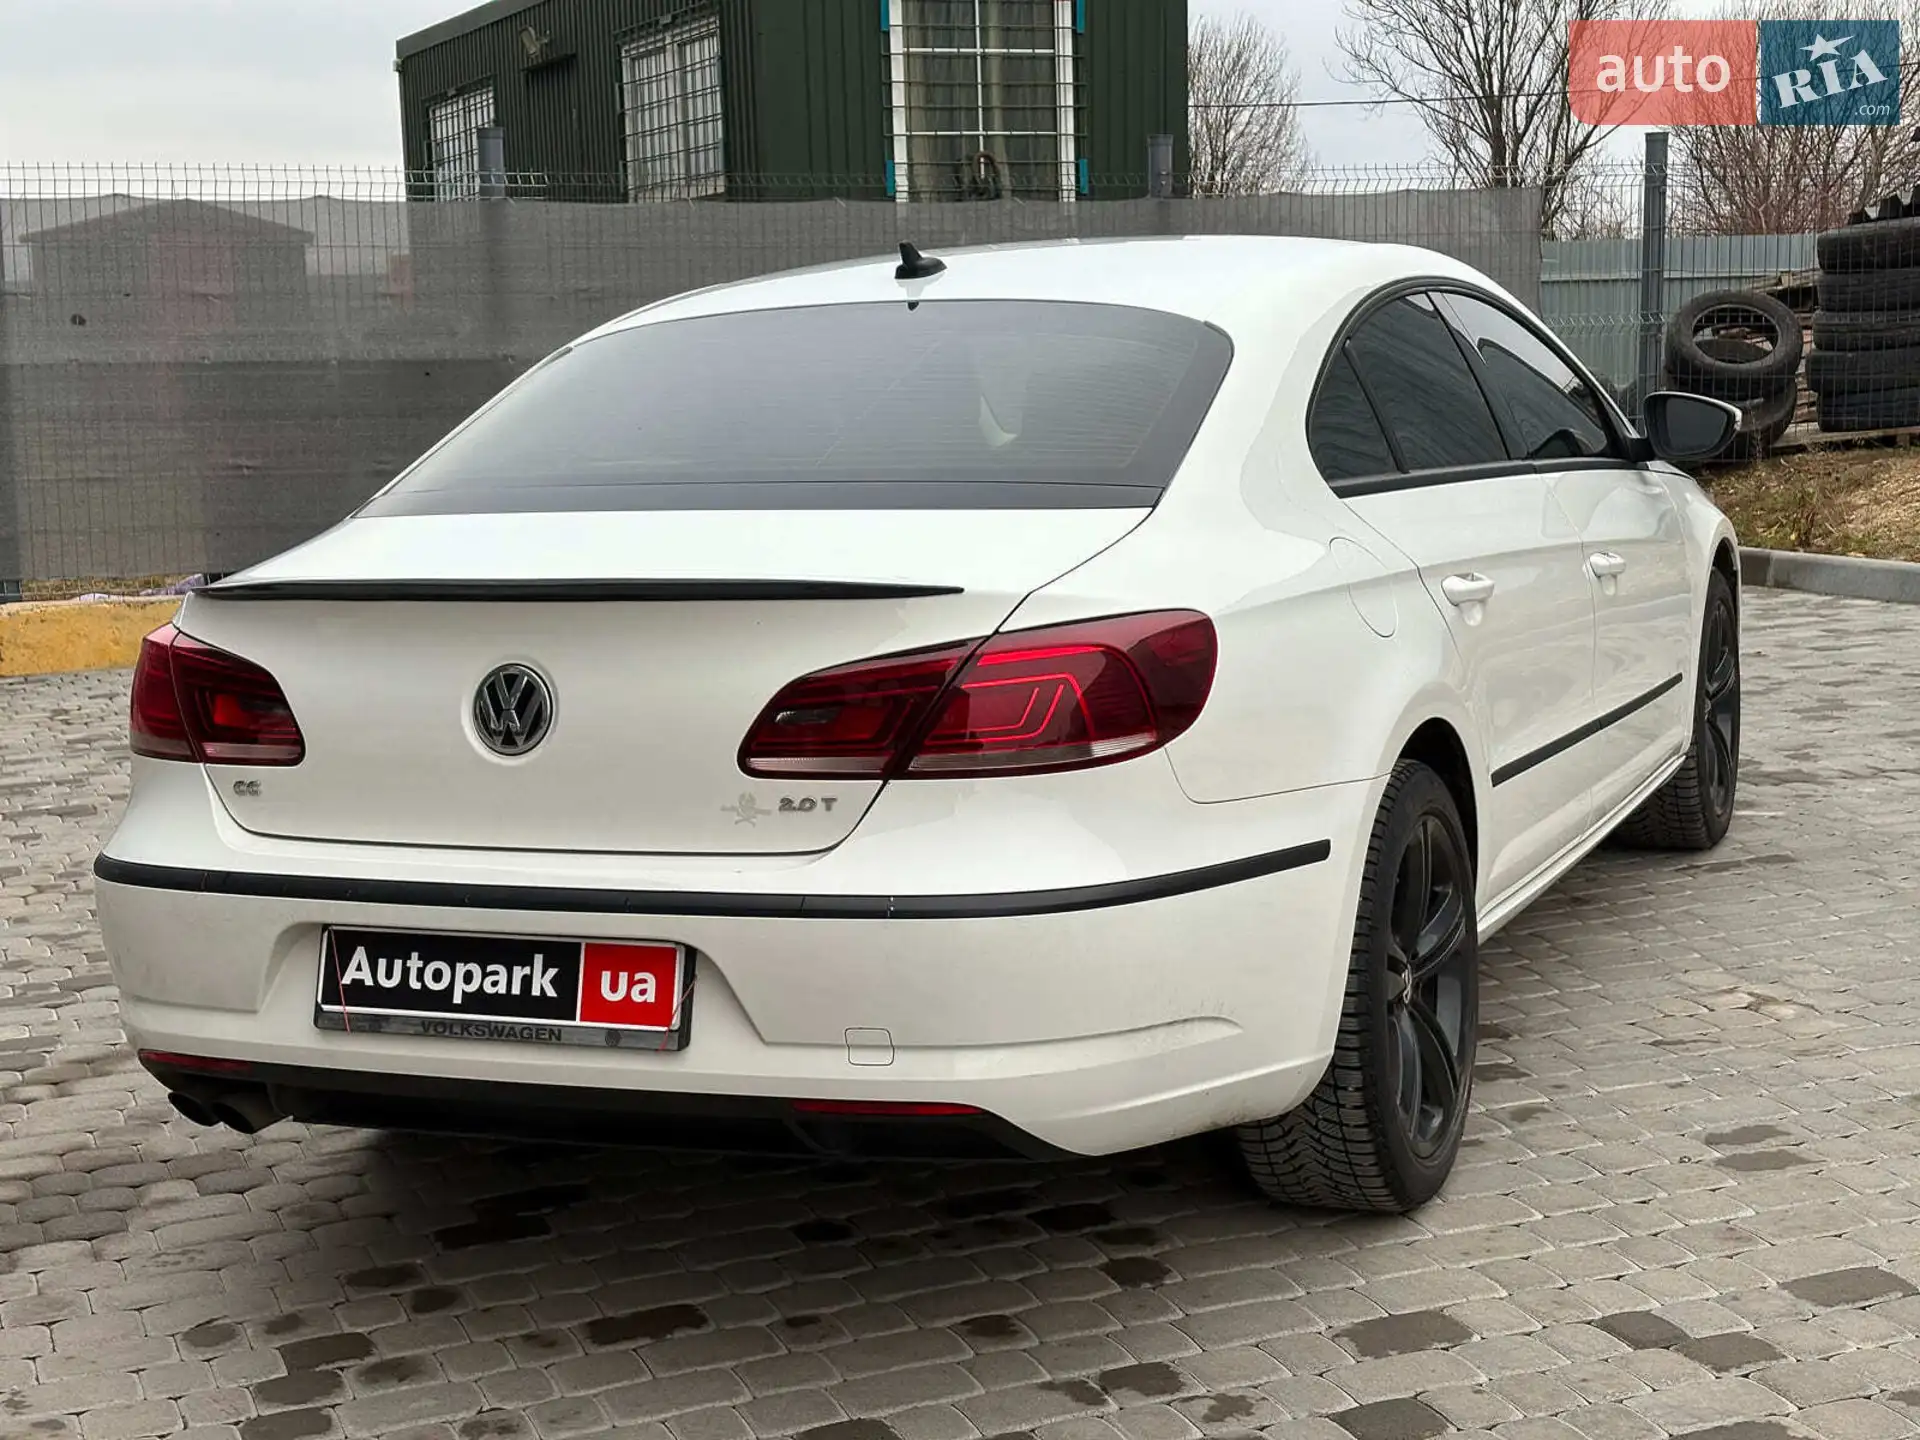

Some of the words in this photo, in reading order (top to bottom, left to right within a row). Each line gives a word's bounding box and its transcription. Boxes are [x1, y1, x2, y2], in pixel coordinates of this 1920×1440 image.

[341, 945, 559, 1004] Autopark
[600, 970, 657, 1003] ua
[421, 1020, 562, 1042] VOLKSWAGEN
